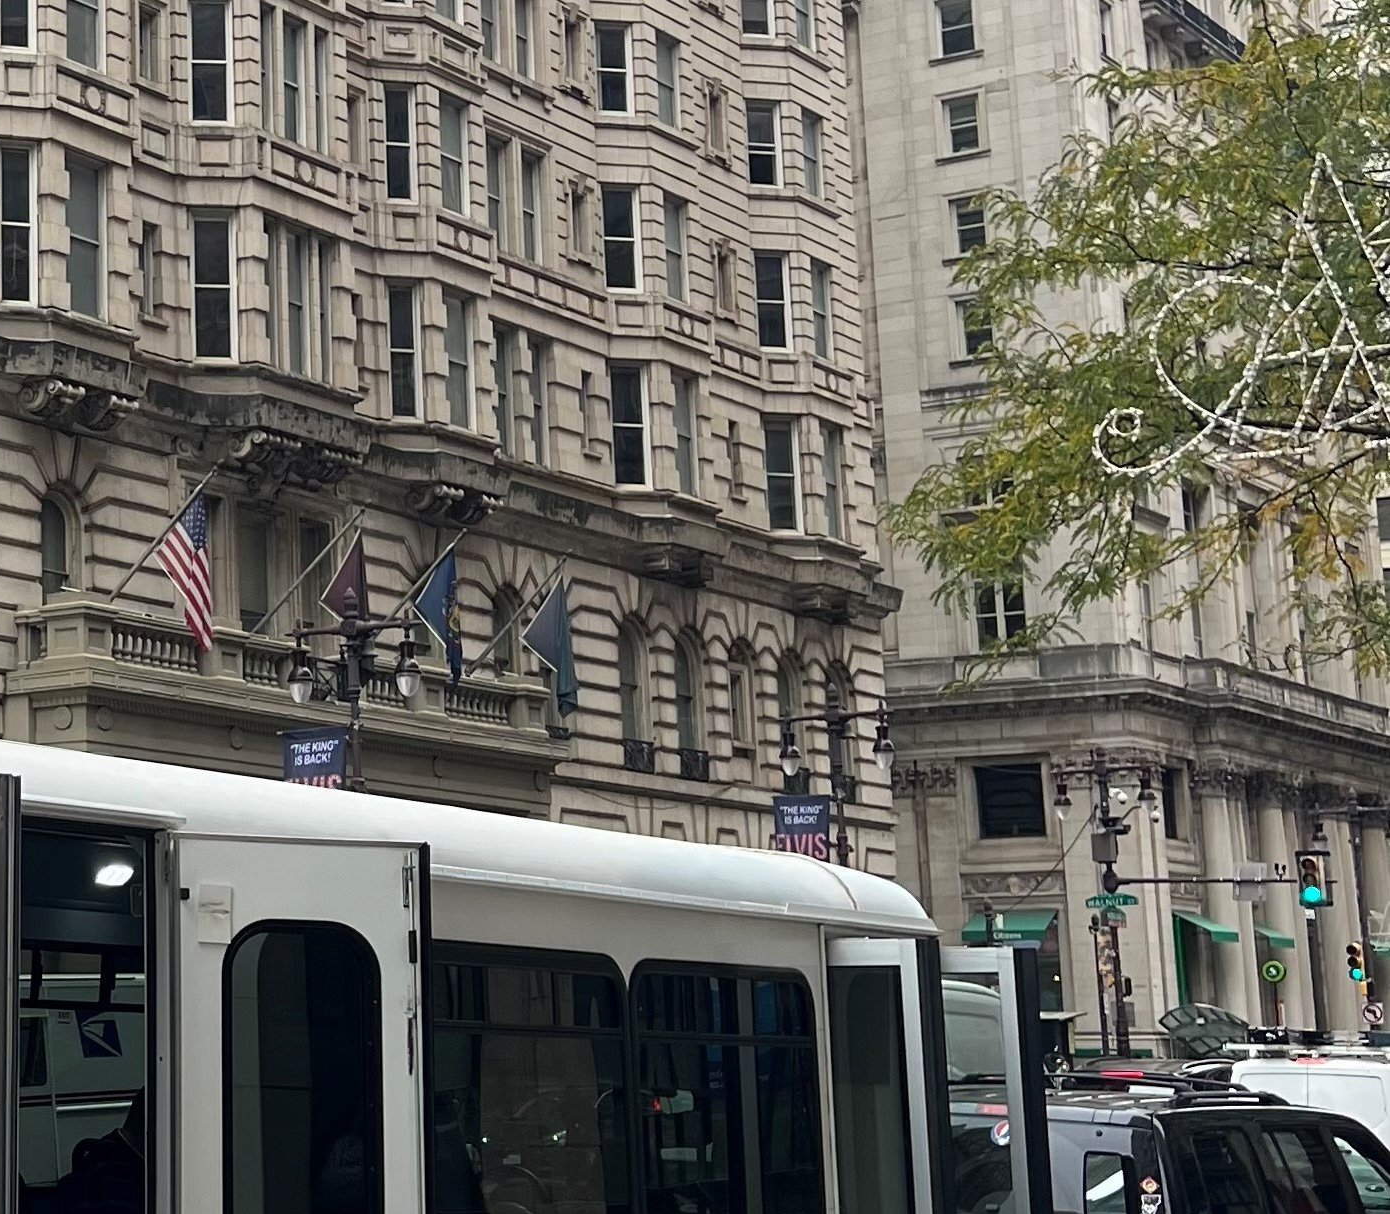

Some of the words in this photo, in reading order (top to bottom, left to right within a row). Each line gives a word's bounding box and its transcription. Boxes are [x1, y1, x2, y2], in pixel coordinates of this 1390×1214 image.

[294, 755, 302, 766] IS
[304, 752, 331, 765] BACK!
[784, 815, 792, 824] IS
[793, 815, 817, 824] BACK!
